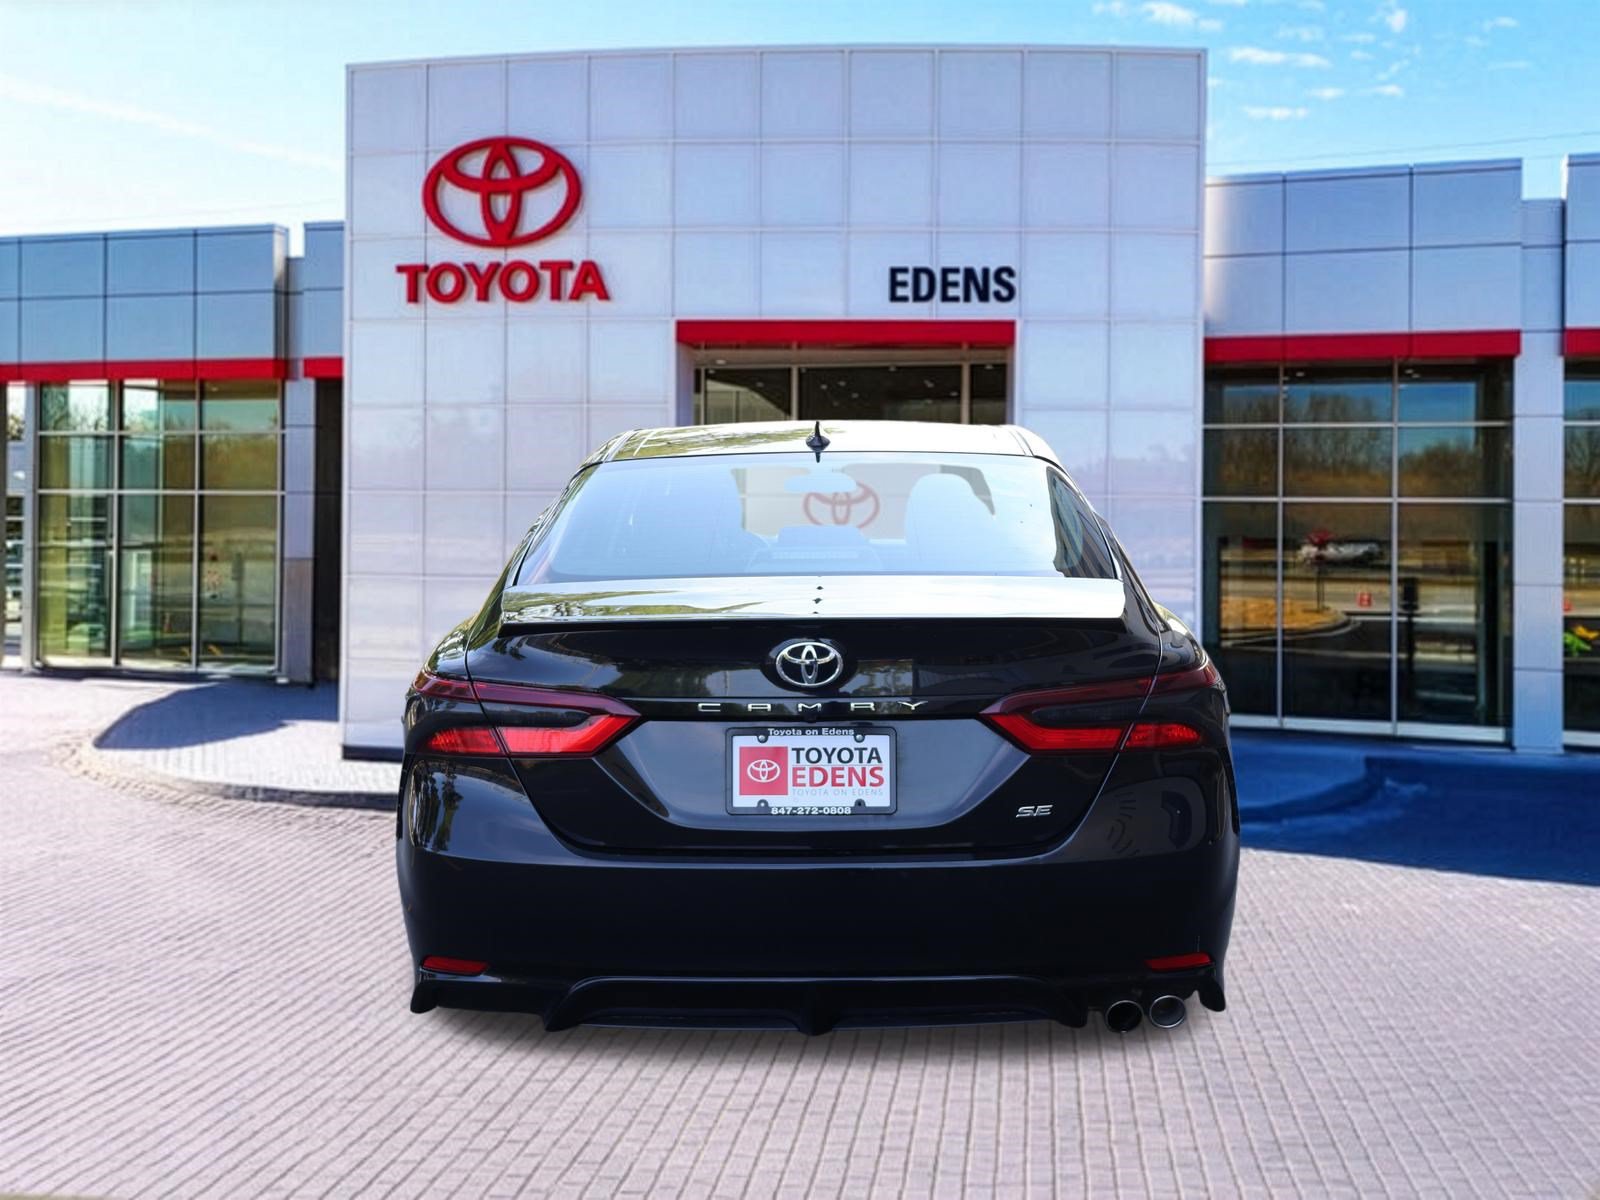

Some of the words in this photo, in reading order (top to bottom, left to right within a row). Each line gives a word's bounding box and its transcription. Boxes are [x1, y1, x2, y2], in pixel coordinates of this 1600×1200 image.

[396, 260, 611, 304] TOYOTA
[889, 266, 1018, 303] EDENS
[698, 701, 928, 712] CAMRY
[768, 728, 802, 737] Toyota
[821, 728, 855, 736] Edens
[791, 747, 883, 764] TOYOTA
[792, 767, 885, 787] EDENS
[792, 788, 830, 796] TOYOTA
[833, 788, 847, 796] ON
[852, 788, 883, 796] EDENS
[771, 806, 852, 815] 847-272-0808
[1016, 804, 1054, 818] SE
